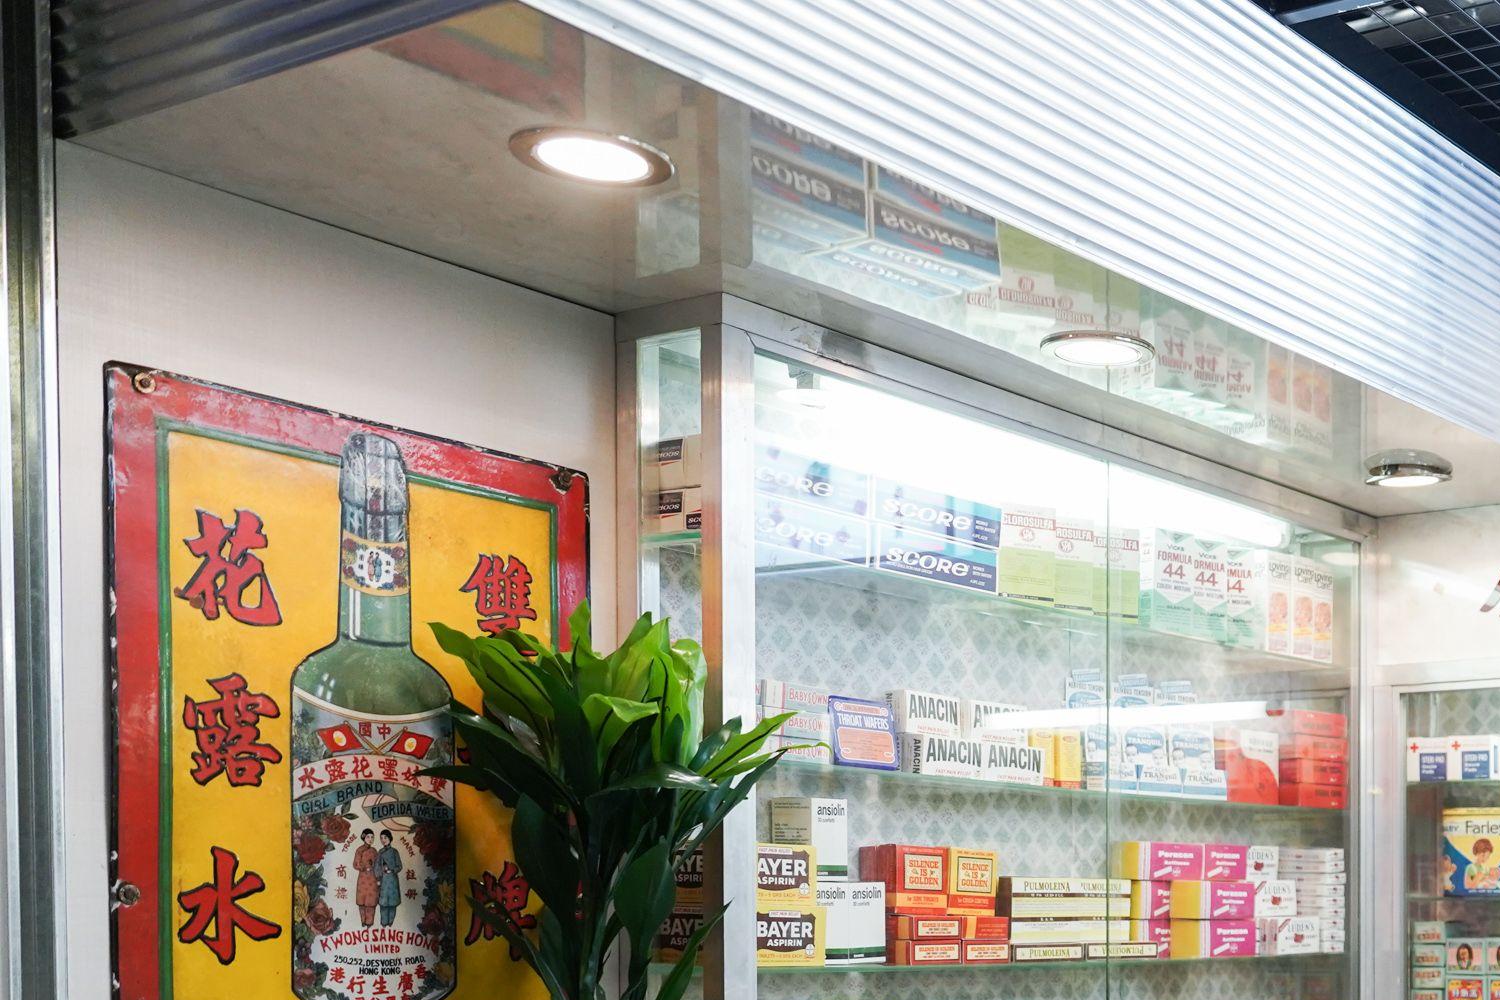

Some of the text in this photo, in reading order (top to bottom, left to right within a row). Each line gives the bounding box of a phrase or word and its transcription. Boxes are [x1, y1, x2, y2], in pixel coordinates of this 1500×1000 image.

[1157, 549, 1193, 565] FORMULA
[1163, 563, 1186, 581] 44
[1194, 559, 1226, 572] ORMULA
[1195, 571, 1219, 588] 44
[909, 694, 958, 726] ANACIN
[838, 713, 891, 731] THROAT WAFERS
[174, 508, 284, 964] 花露水
[913, 738, 921, 774] ANACIN
[926, 737, 983, 768] ANACIN
[988, 744, 1042, 774] ANACIN
[301, 780, 383, 815] GIRL BRAND
[372, 803, 450, 821] FLORIDA WATER
[817, 803, 845, 818] ansiolin
[757, 859, 808, 877] AYER
[908, 859, 939, 869] SILENCE
[961, 862, 989, 872] SILENCE
[908, 876, 939, 886] GOLDEN
[961, 878, 989, 888] GOLDEN
[1023, 880, 1070, 893] PULMOLEINA
[816, 887, 846, 900] ansiolin
[852, 887, 882, 900] ansiolin
[757, 921, 814, 939] BAYER
[320, 928, 404, 953] KWONG SANG
[766, 938, 804, 948] ASPIRIN
[365, 944, 400, 954] LIMITED
[1029, 947, 1071, 959] PULMOLEINA
[359, 967, 401, 975] HONG KONG
